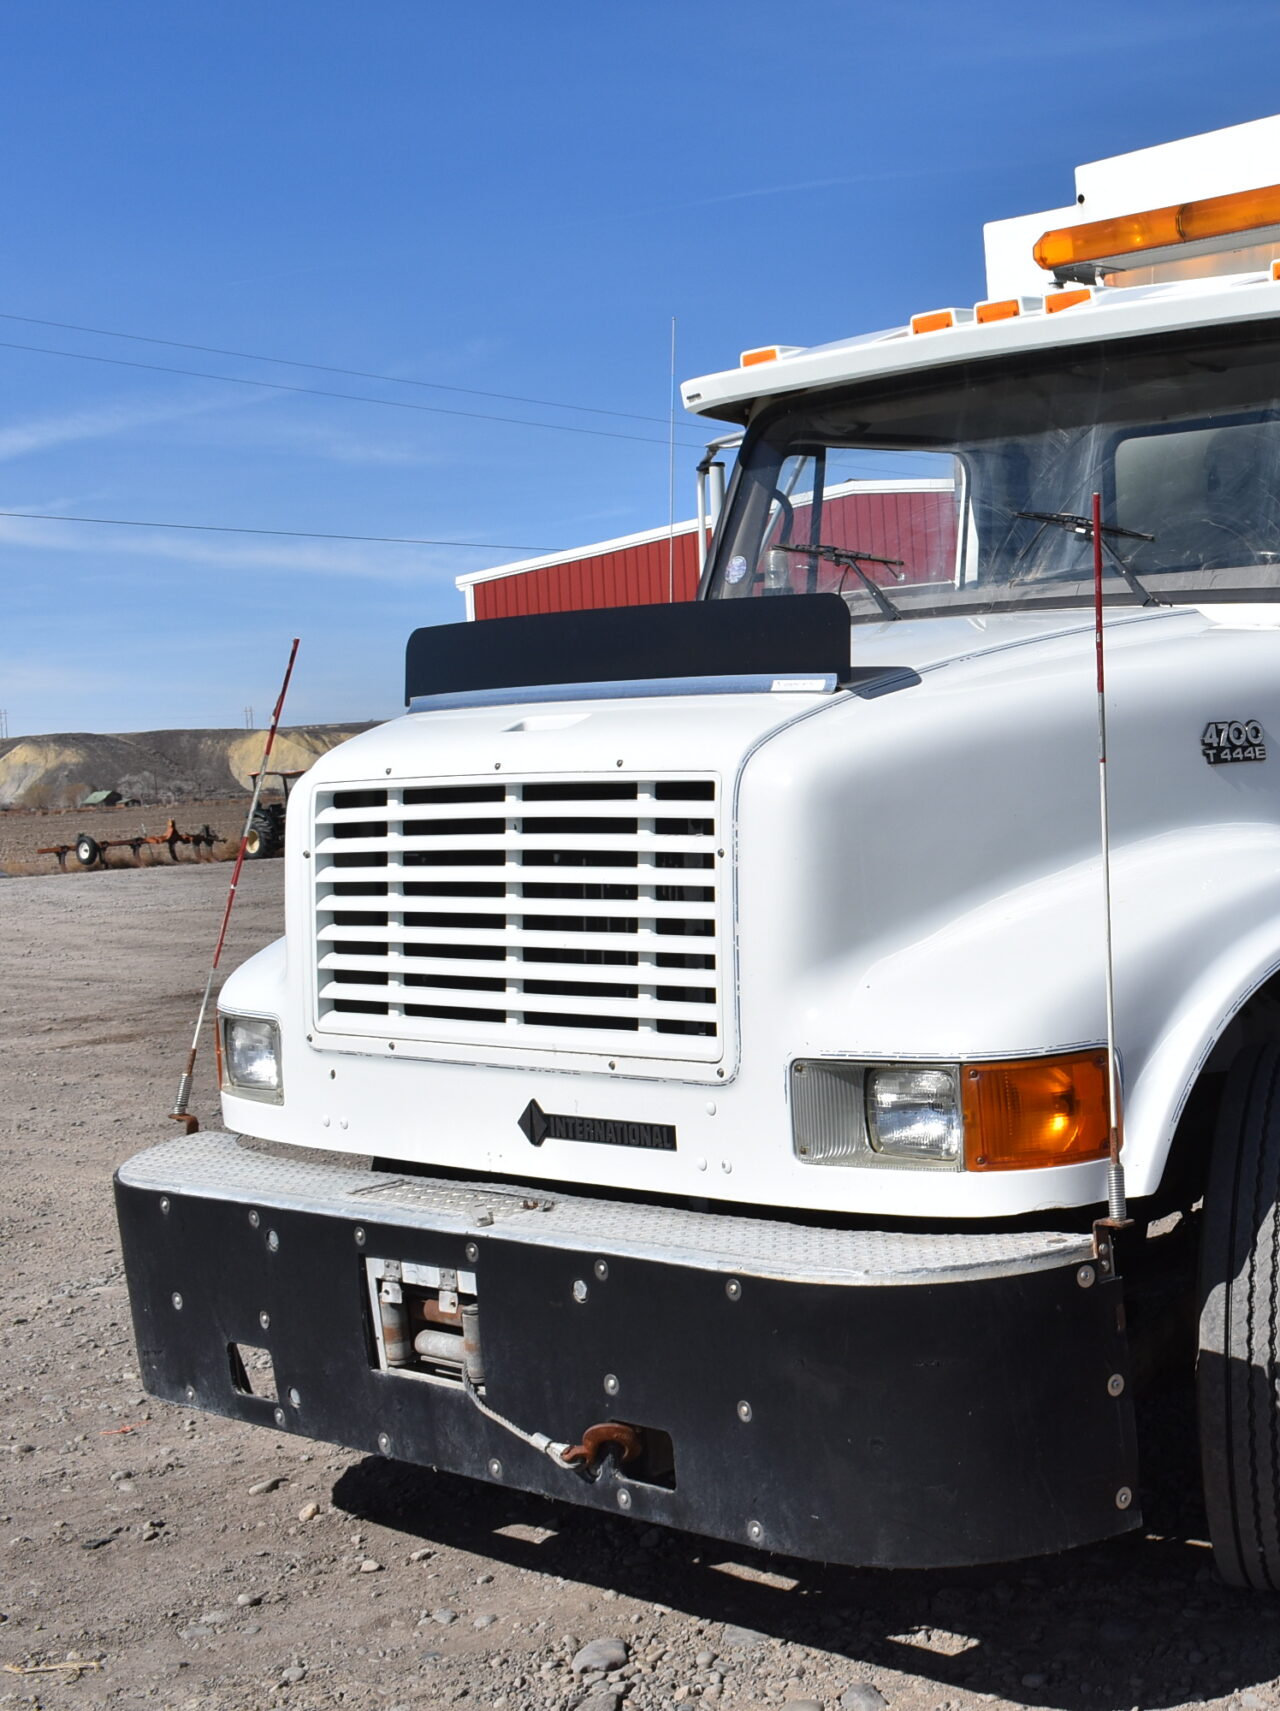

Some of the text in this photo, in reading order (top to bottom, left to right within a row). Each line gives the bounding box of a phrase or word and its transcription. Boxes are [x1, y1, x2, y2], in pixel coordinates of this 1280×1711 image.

[1201, 720, 1264, 747] 4700
[1204, 746, 1266, 762] T 444E
[549, 1116, 673, 1148] INTERNATIONAL
